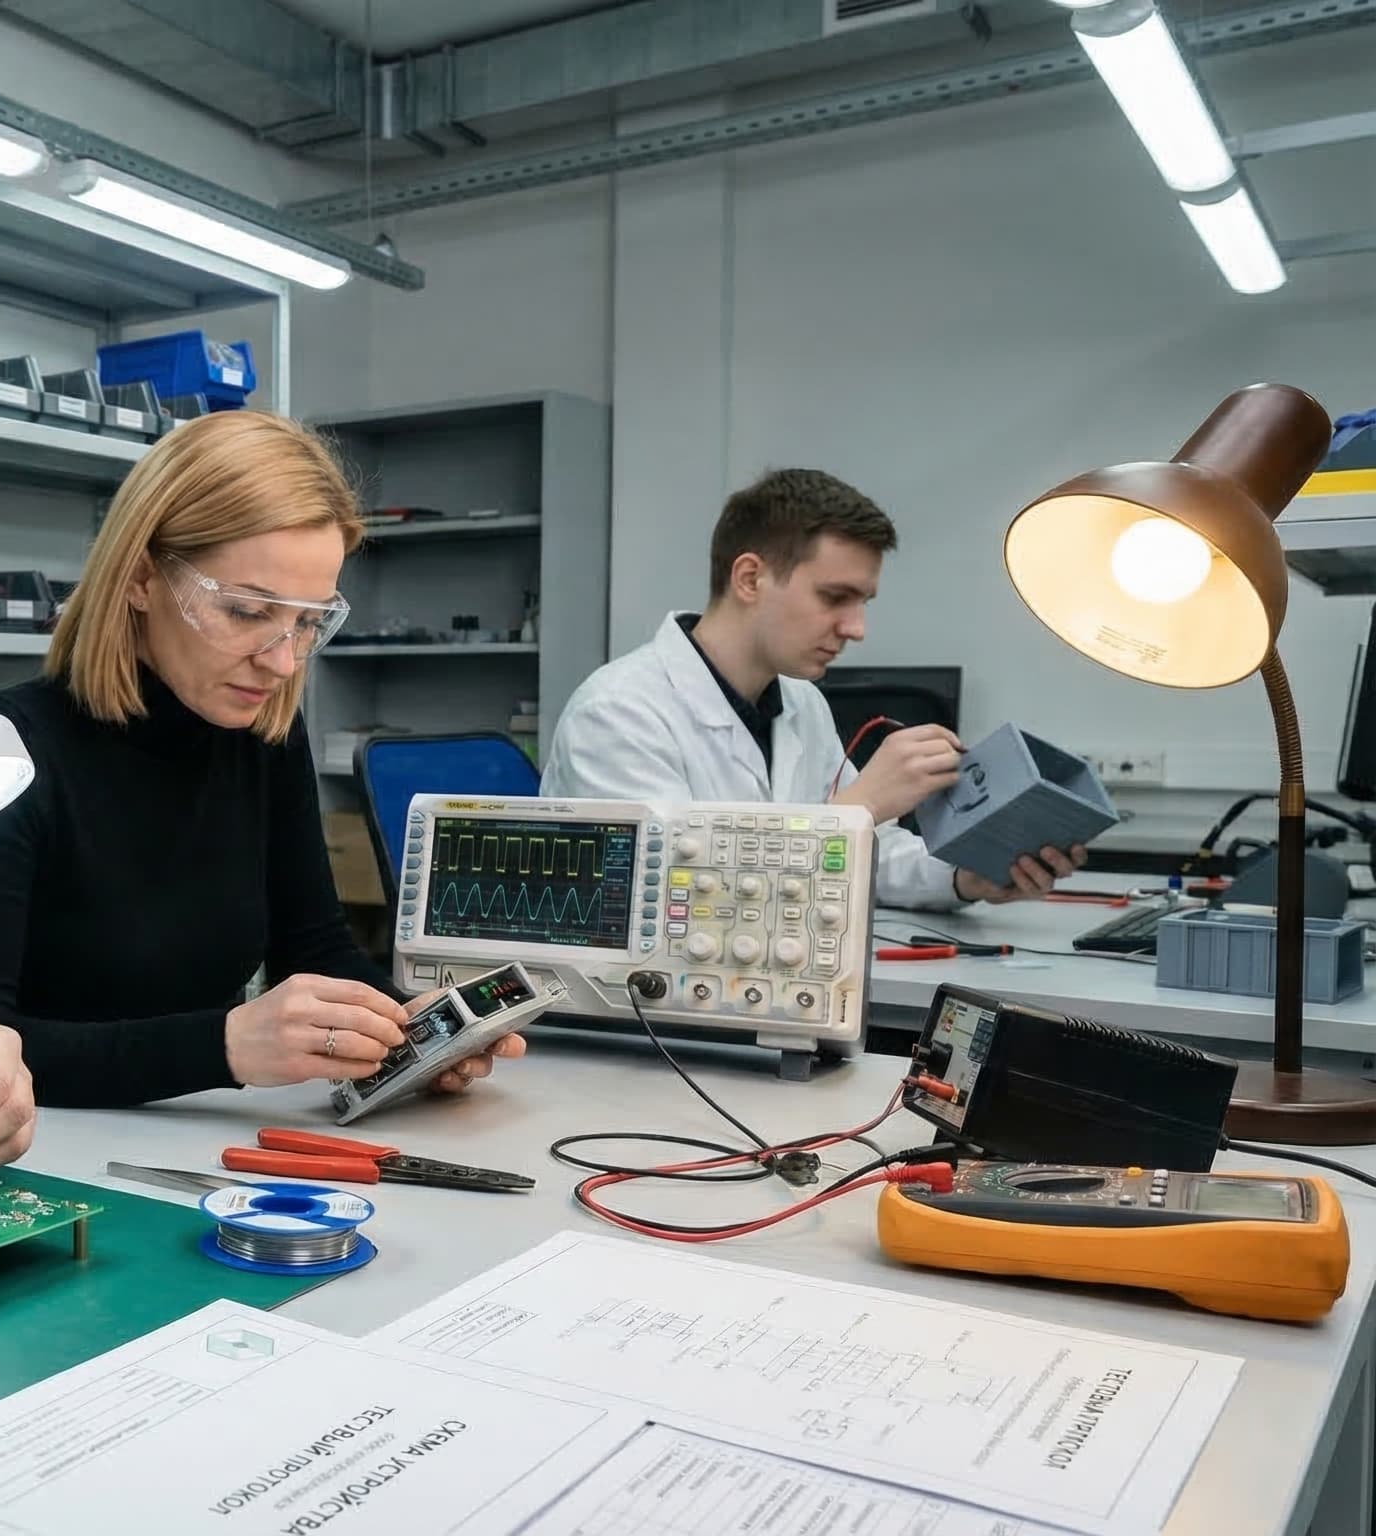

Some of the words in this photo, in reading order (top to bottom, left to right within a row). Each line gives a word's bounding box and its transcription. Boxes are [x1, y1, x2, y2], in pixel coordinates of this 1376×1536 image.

[401, 1419, 467, 1458] СХЕМА
[208, 1453, 312, 1515] ПРОТОКОЛ
[280, 1456, 415, 1536] УСТРОЙСТВА
